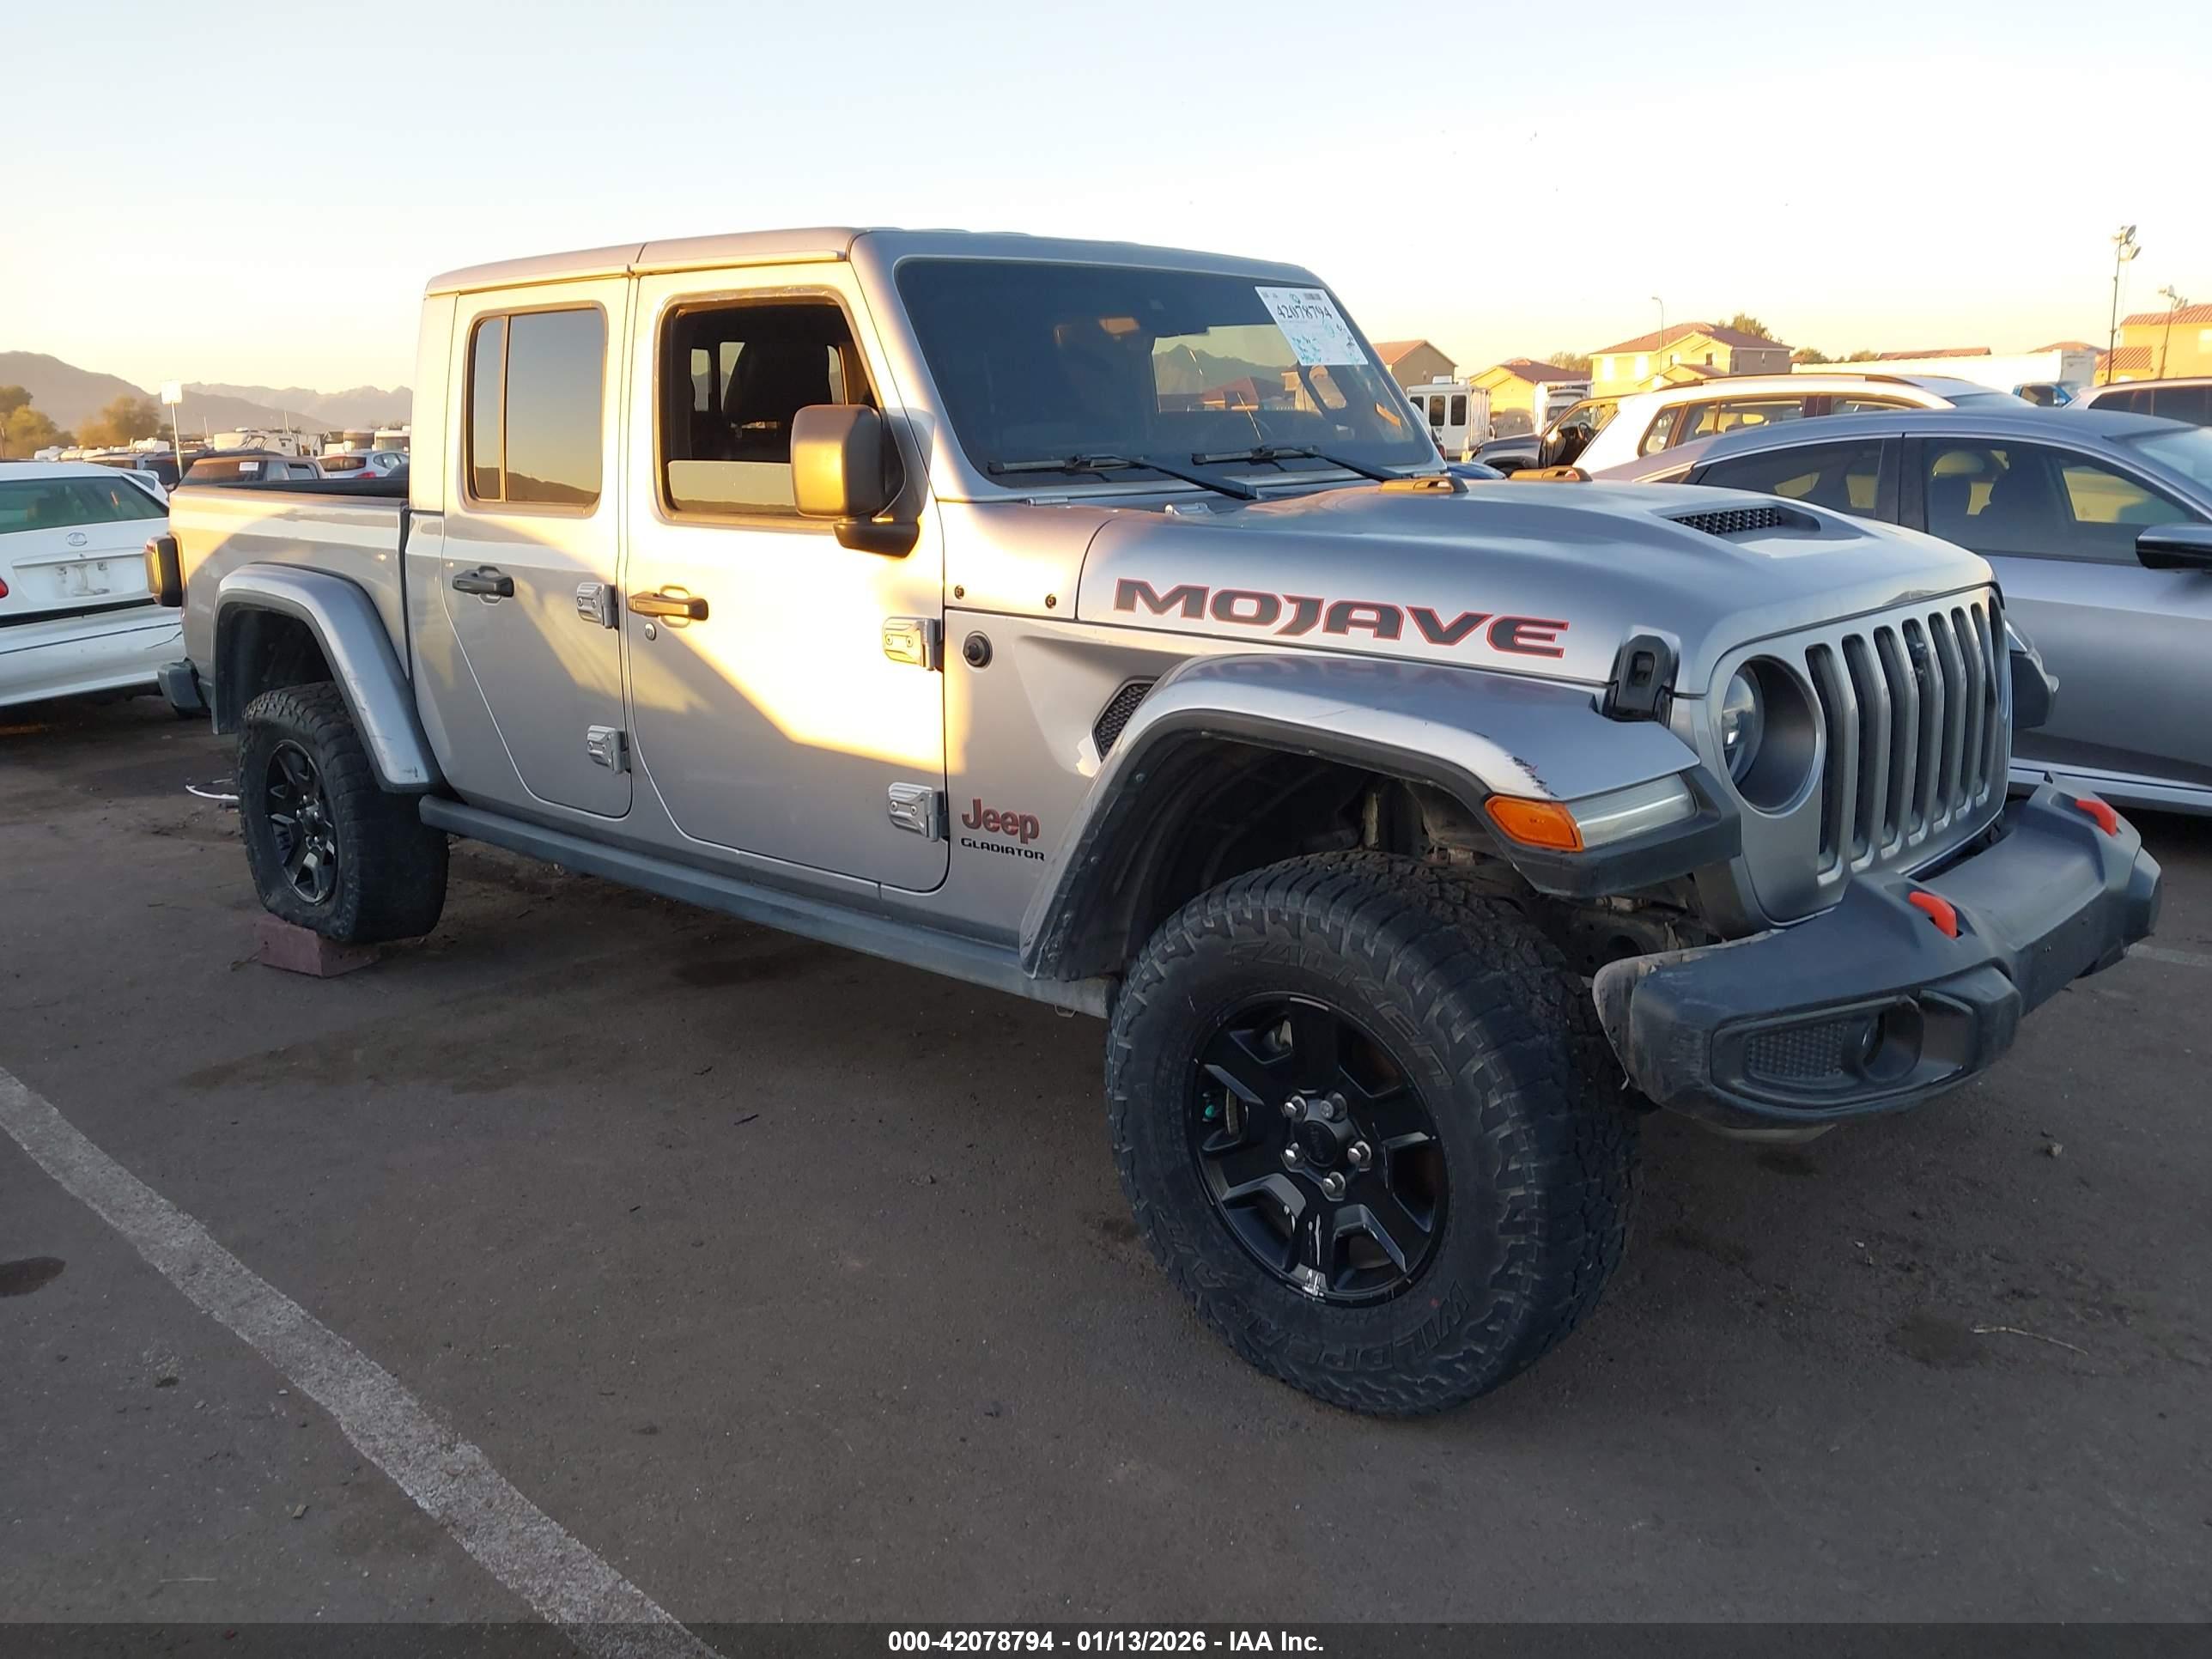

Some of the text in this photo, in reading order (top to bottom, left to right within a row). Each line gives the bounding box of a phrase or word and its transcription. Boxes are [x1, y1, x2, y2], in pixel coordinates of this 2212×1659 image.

[1276, 303, 1333, 320] 42078794
[1114, 577, 1570, 658] MOJAVE
[962, 798, 1040, 844] Jeep
[961, 837, 1045, 862] GLADIATOR
